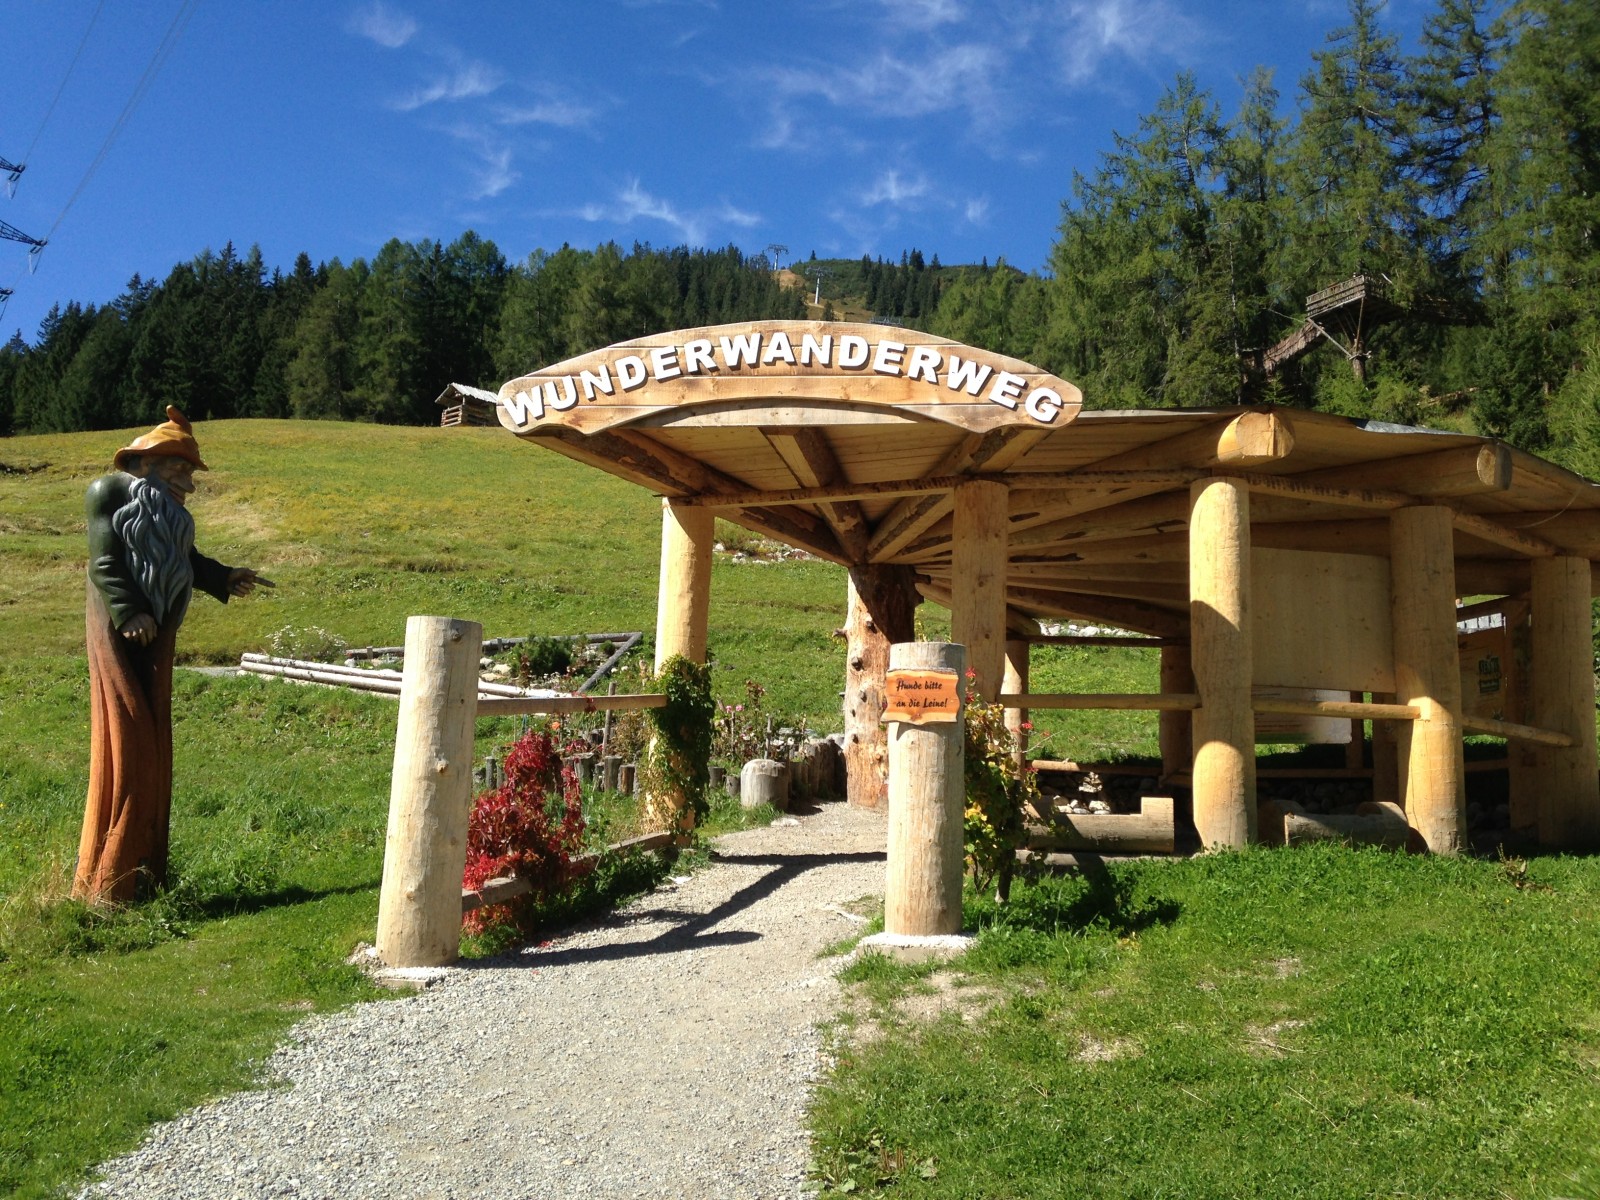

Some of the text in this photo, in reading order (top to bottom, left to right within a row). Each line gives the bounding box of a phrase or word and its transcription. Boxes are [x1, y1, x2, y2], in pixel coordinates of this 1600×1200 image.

[503, 332, 1063, 426] WUNDERWANDERWEG
[896, 680, 942, 691] Hunde bitte
[908, 699, 920, 708] die
[923, 697, 948, 708] Leine!
